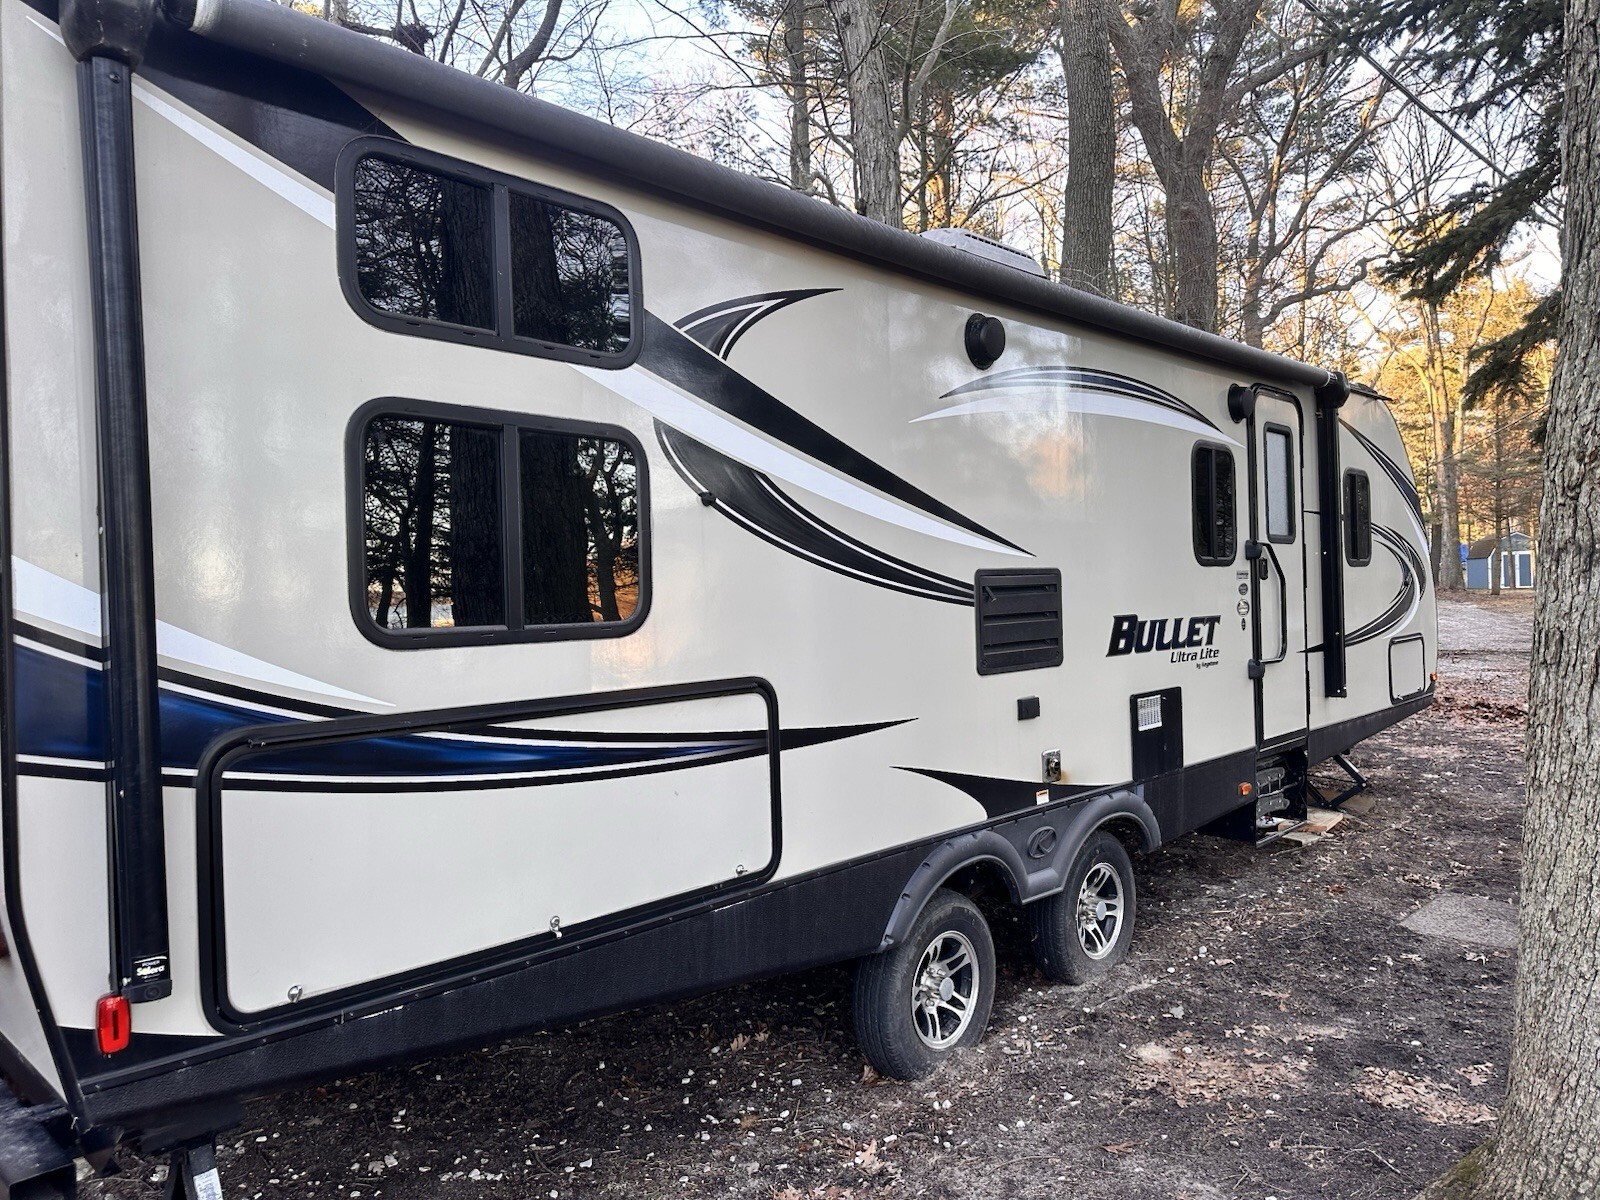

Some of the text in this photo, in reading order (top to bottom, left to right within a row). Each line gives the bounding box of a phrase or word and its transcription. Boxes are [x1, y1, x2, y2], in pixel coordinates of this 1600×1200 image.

[1105, 614, 1221, 657] BULLET
[1170, 648, 1219, 663] Ultra Lite
[136, 965, 165, 976] Solera
